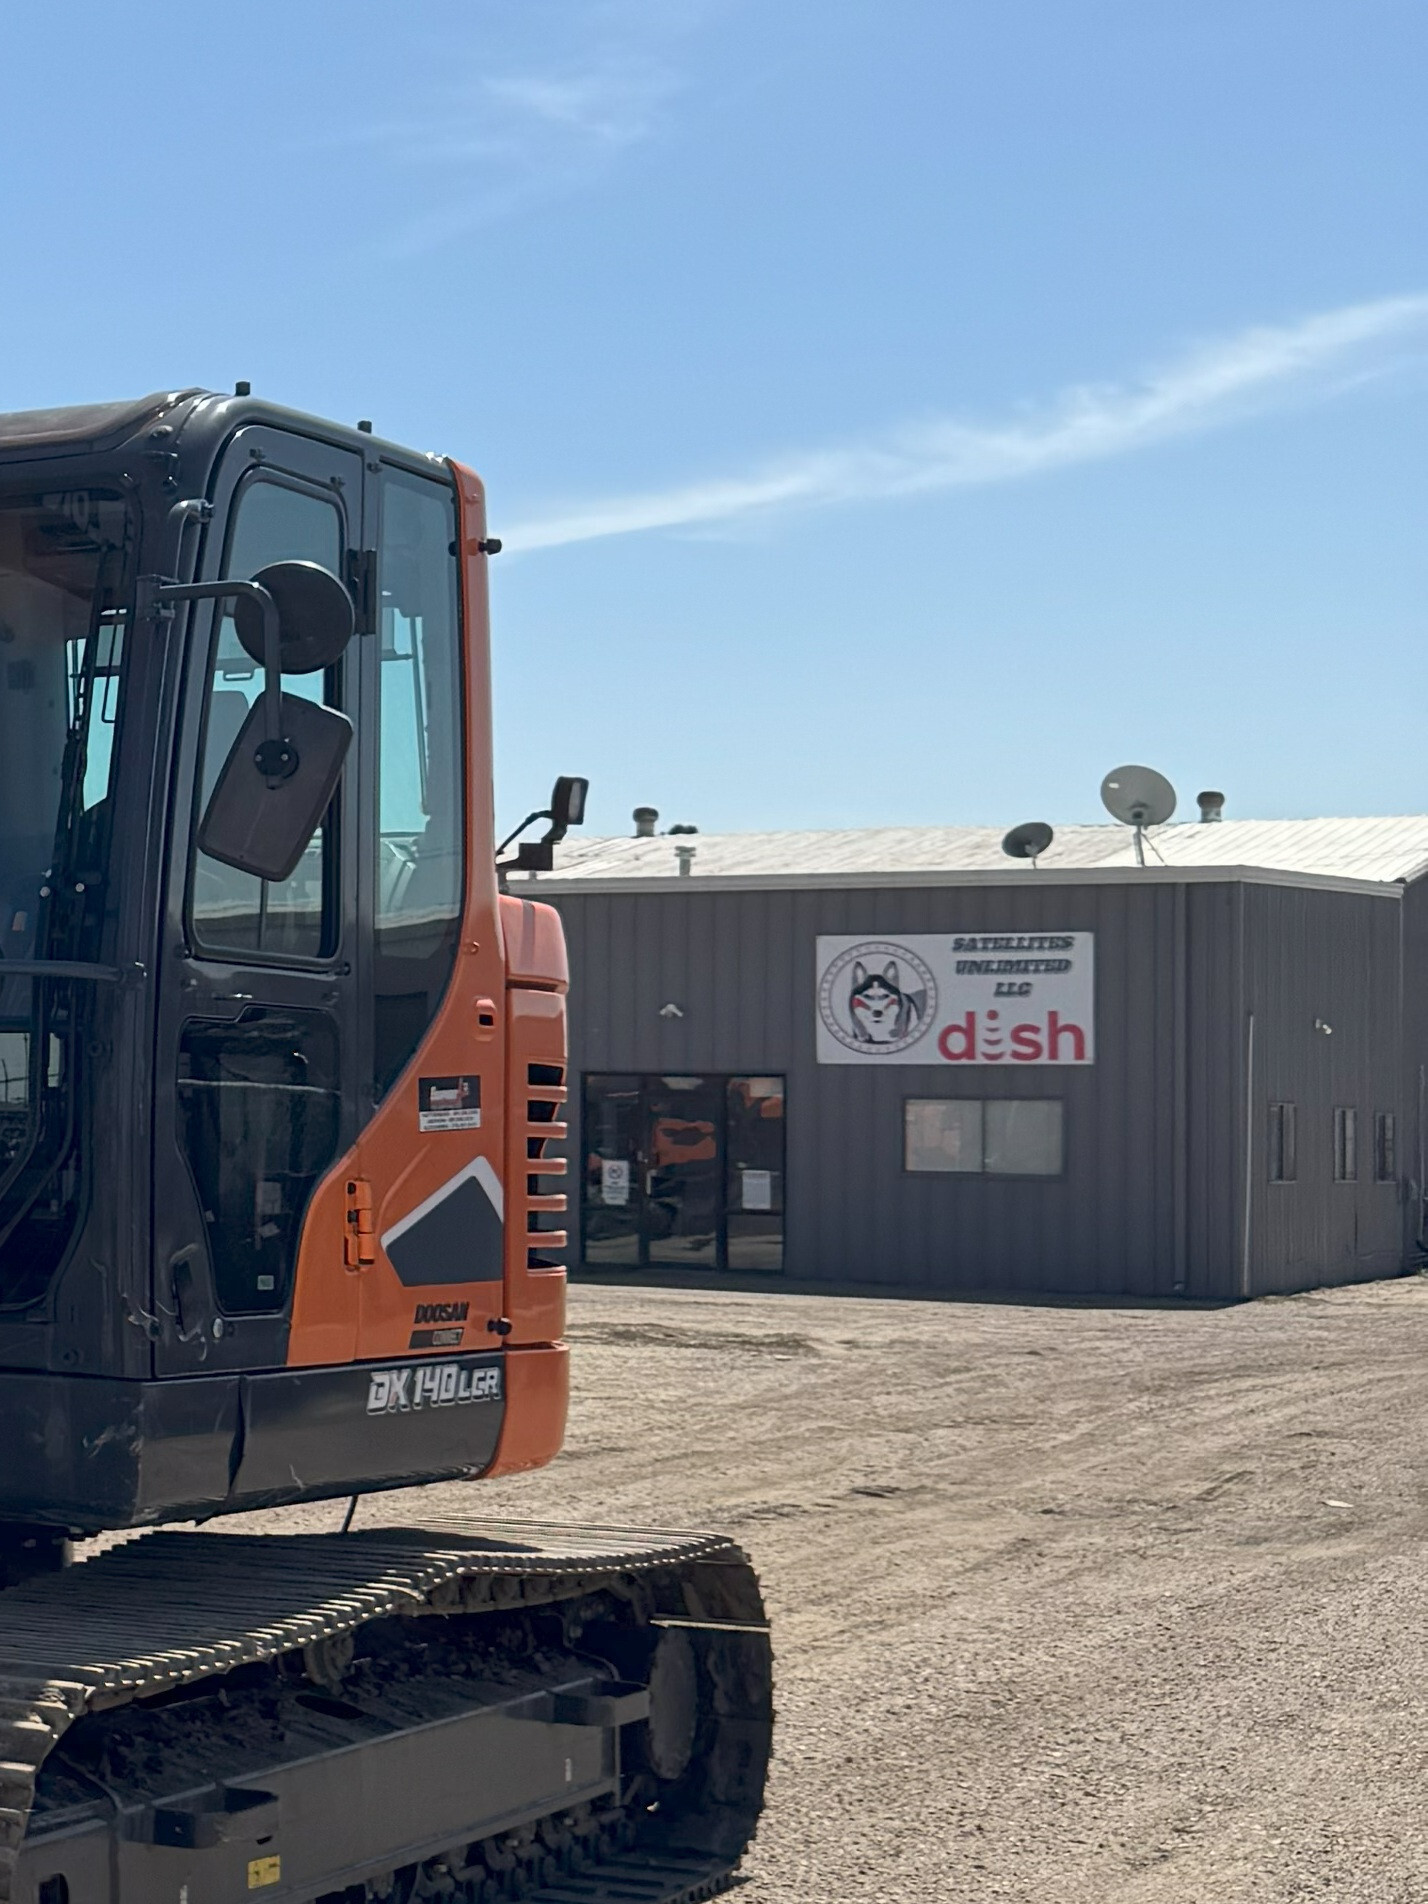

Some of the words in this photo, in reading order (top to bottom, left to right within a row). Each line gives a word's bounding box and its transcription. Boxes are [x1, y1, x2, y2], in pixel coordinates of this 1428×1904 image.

[952, 936, 1075, 953] SATELLITES
[955, 959, 1072, 975] UNLIMITED
[993, 982, 1032, 997] LLC
[938, 1009, 1086, 1061] dish
[414, 1302, 469, 1324] DOOSAN
